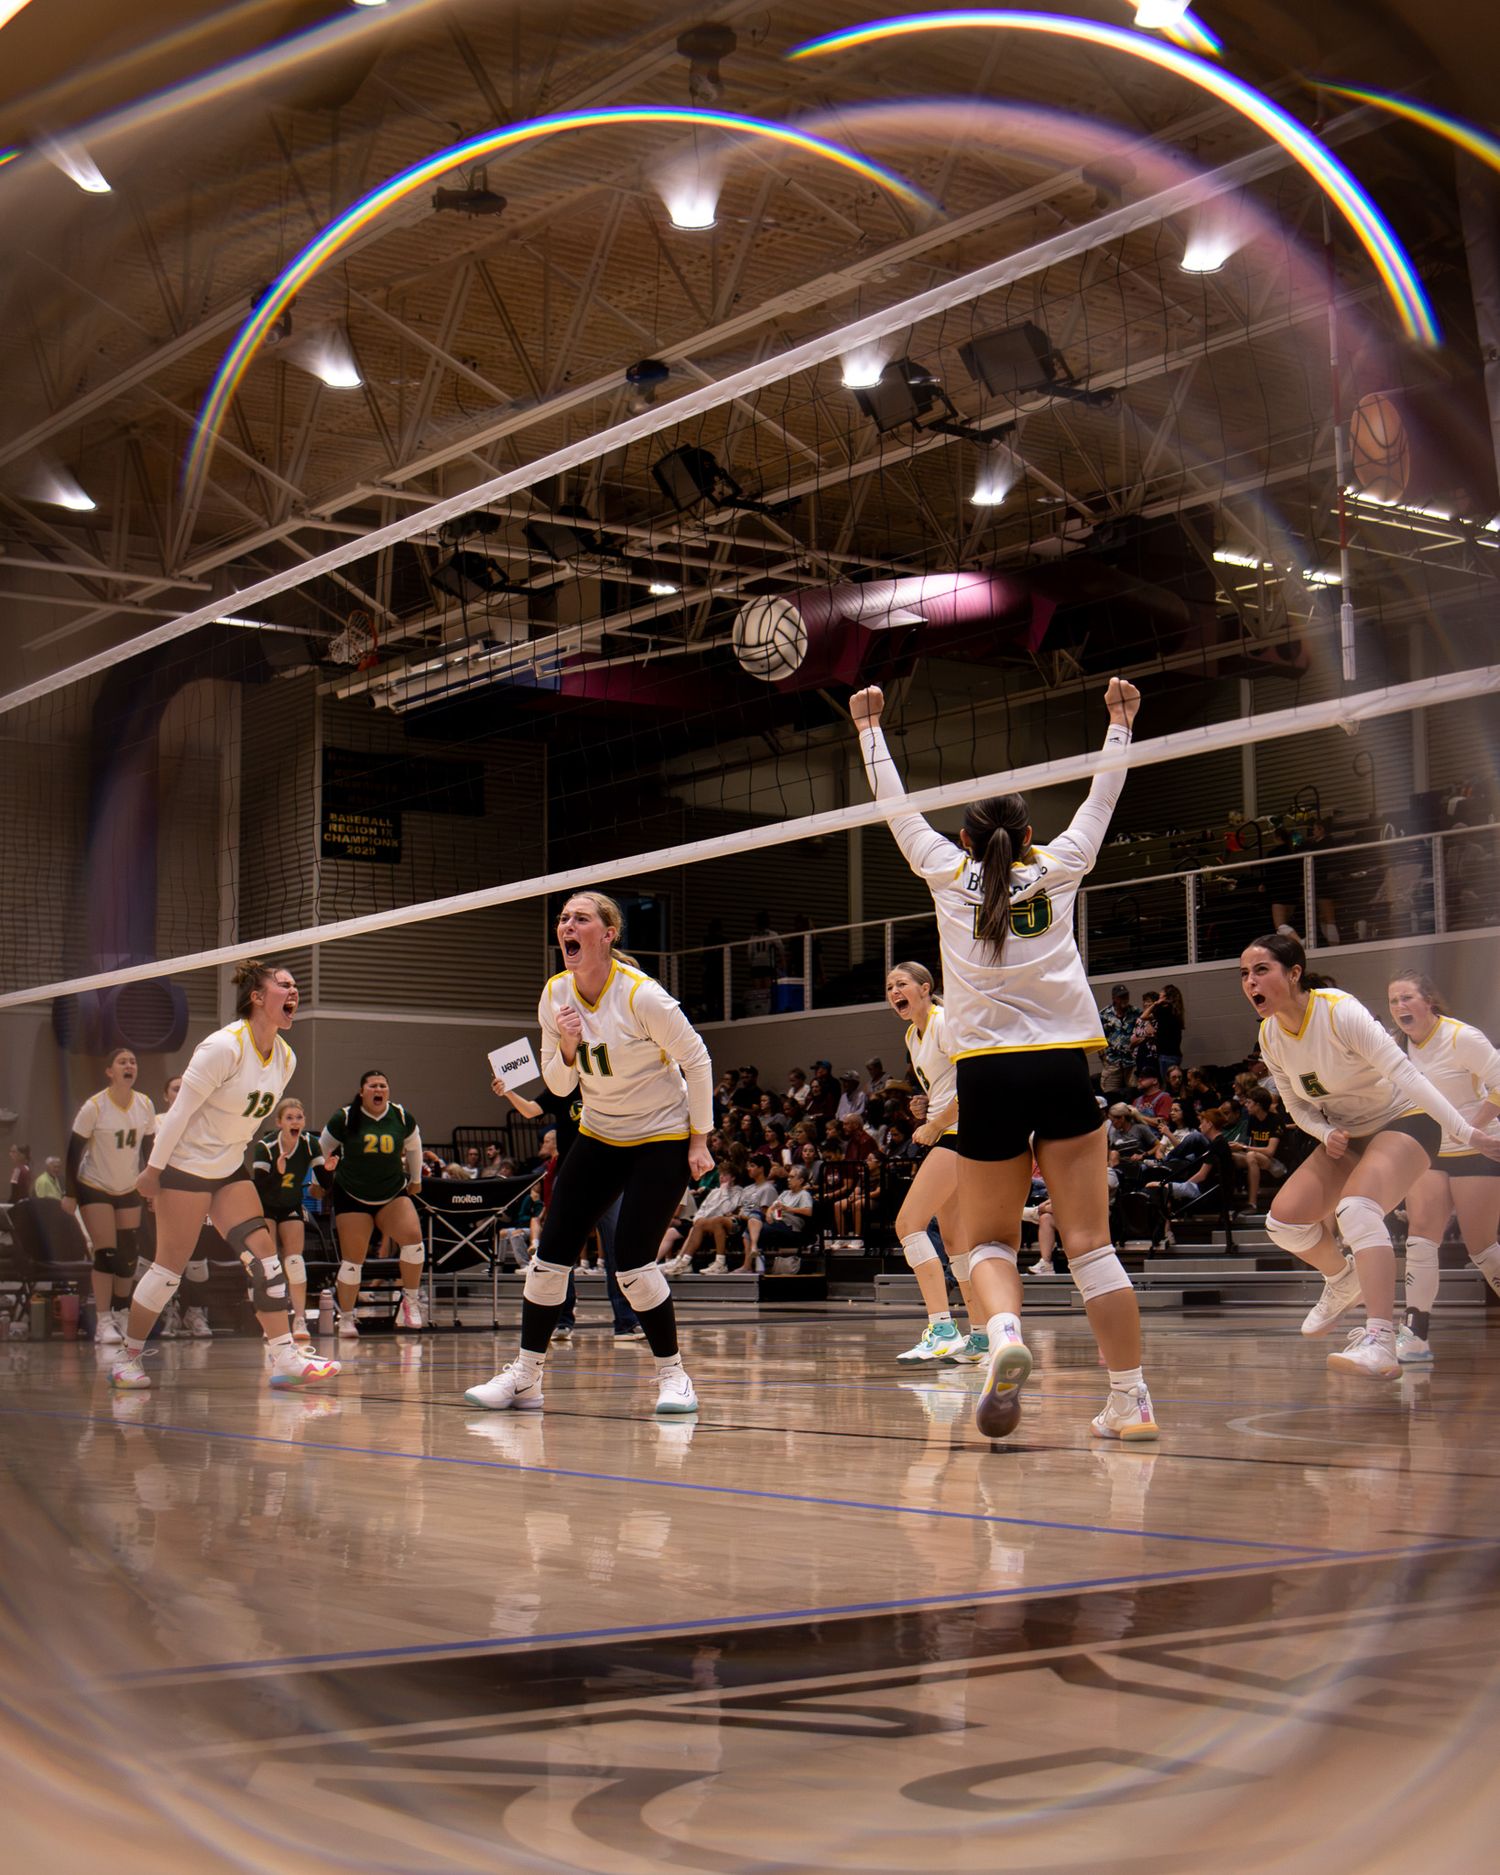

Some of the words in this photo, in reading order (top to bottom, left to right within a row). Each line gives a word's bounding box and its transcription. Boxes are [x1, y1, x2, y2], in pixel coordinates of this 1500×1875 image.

[328, 822, 378, 836] REGION
[329, 812, 394, 827] BASEBALL
[323, 832, 399, 848] CHAMPIONS
[501, 1055, 530, 1074] molten
[577, 1041, 613, 1077] 11
[1299, 1072, 1330, 1097] 5
[240, 1090, 275, 1118] 13
[114, 1128, 137, 1149] 14
[363, 1134, 394, 1153] 20
[281, 1172, 295, 1188] 2
[451, 1193, 483, 1204] molten
